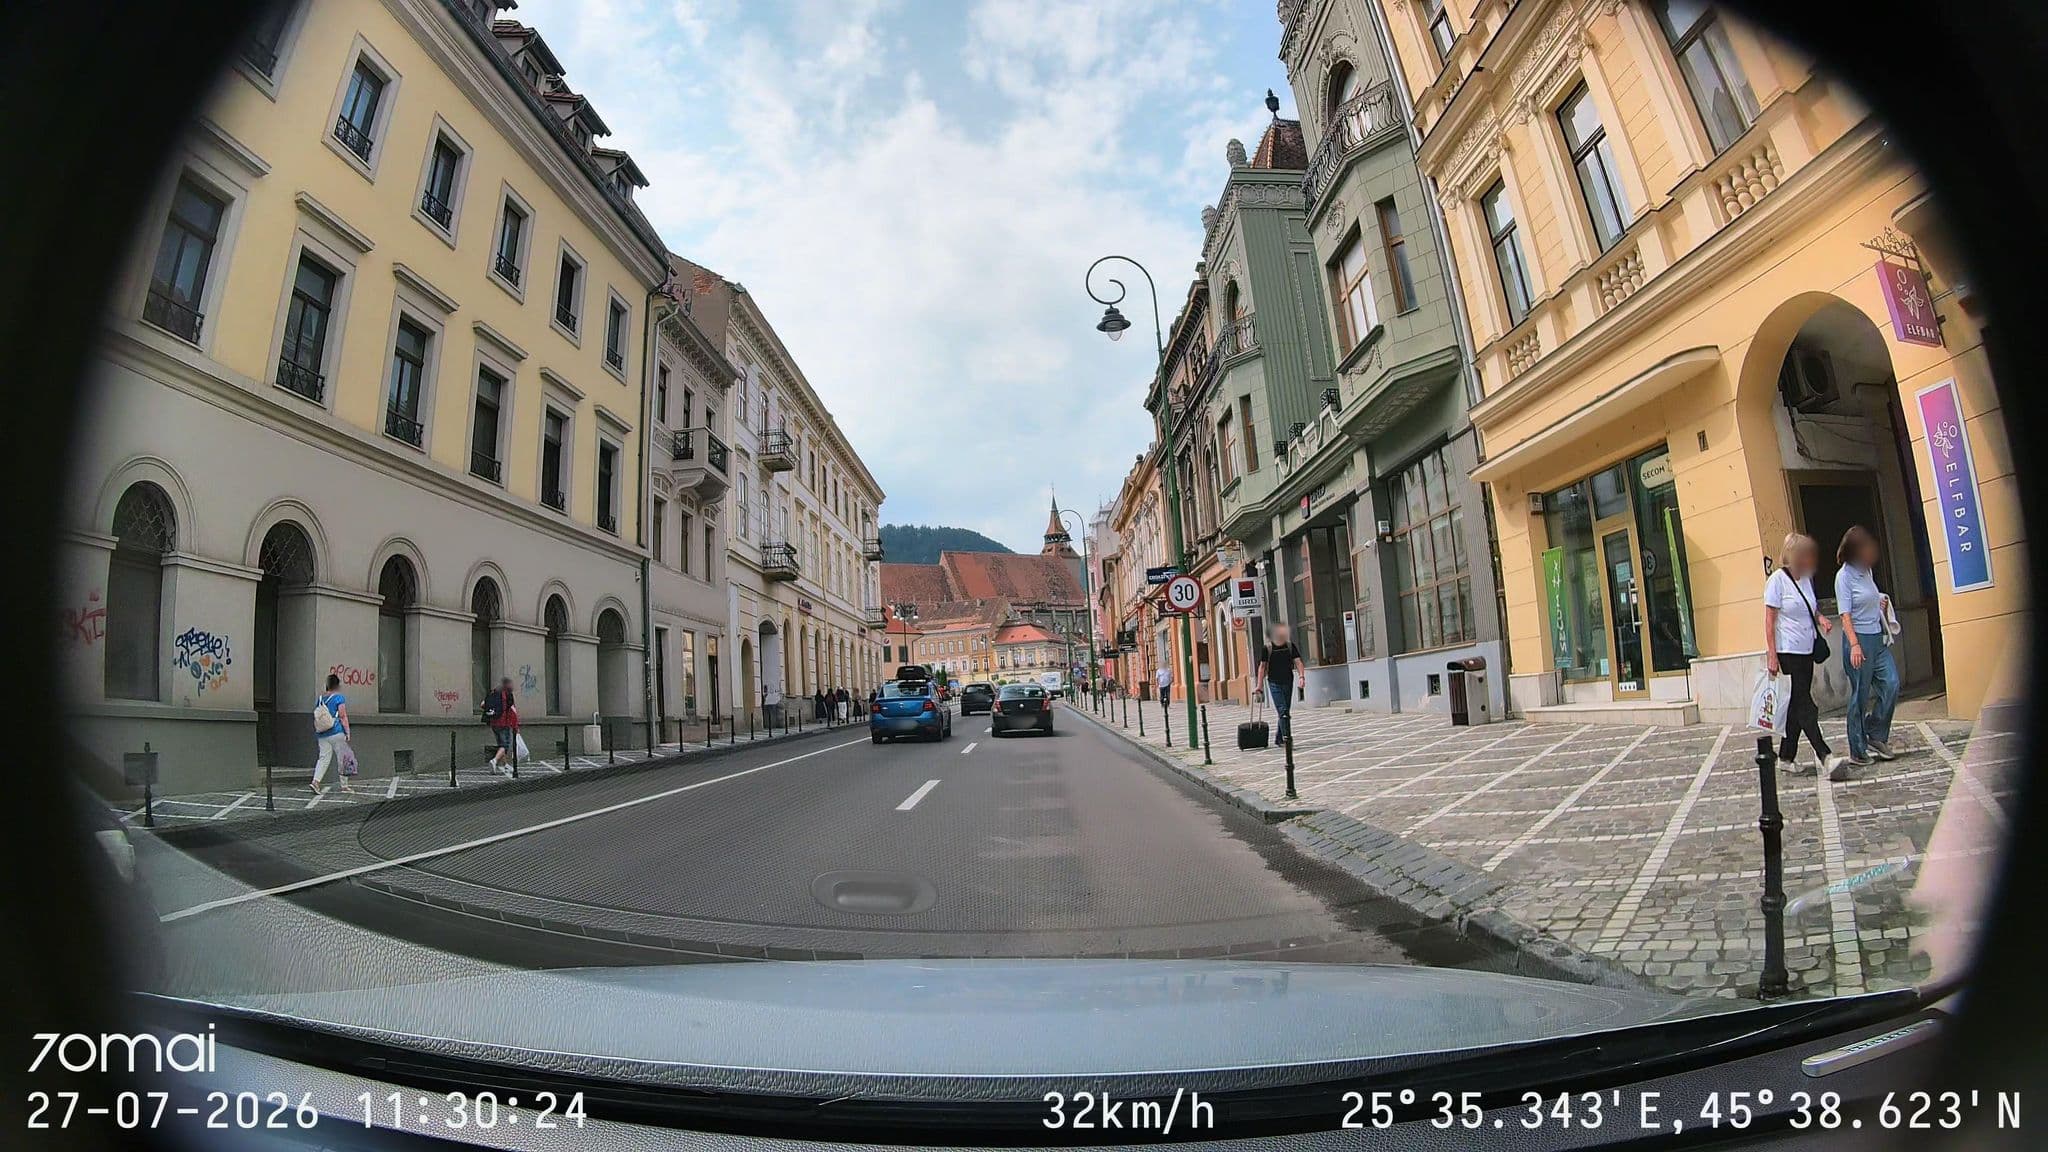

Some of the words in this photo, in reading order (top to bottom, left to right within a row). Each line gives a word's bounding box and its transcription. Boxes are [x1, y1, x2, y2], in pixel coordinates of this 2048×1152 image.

[1906, 322, 1937, 340] ELFBAR
[1641, 464, 1666, 481] SECOM
[1945, 461, 1973, 553] ELFBAR
[1174, 583, 1194, 602] 30
[1238, 598, 1258, 606] BRD
[1555, 594, 1568, 653] SECOM
